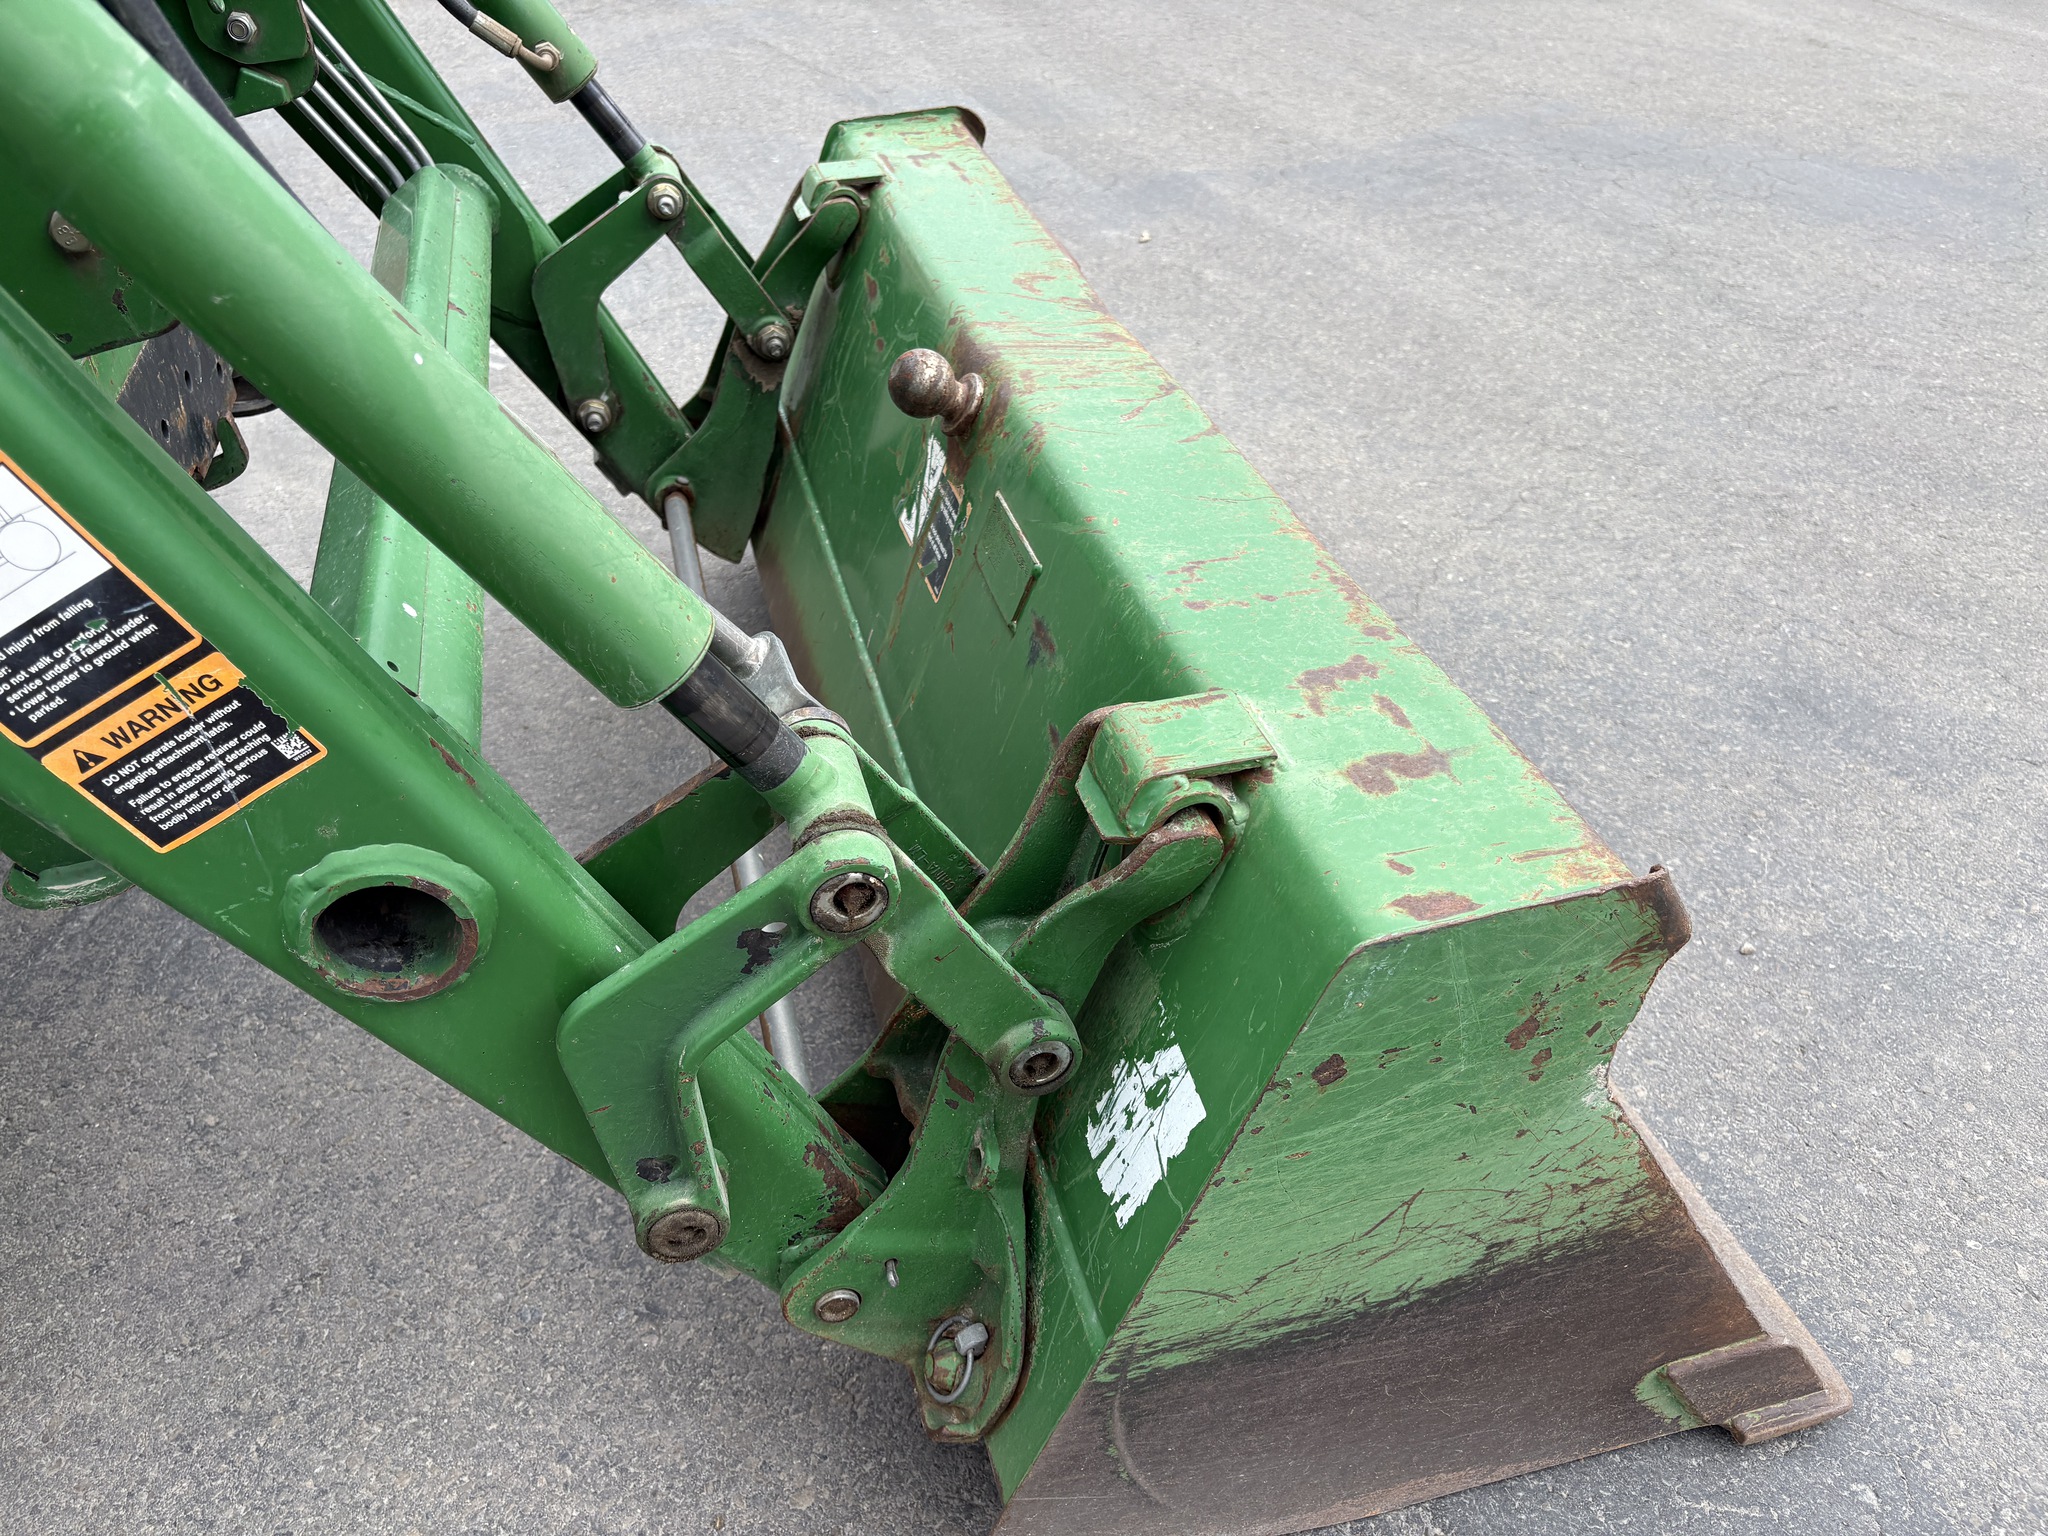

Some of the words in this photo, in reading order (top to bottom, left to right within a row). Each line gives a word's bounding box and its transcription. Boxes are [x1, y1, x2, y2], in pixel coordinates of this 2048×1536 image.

[4, 633, 34, 656] injury
[33, 618, 61, 637] from
[58, 598, 93, 621] falling
[6, 678, 44, 704] service
[43, 658, 76, 681] under
[73, 654, 82, 663] a
[81, 634, 115, 657] raised
[113, 614, 150, 638] loader.
[11, 670, 32, 685] not
[31, 656, 54, 672] walk
[53, 648, 66, 659] or
[15, 691, 49, 713] Lower
[46, 670, 81, 694] loader
[80, 663, 94, 674] to
[93, 641, 130, 666] ground
[128, 624, 159, 643] when
[29, 696, 68, 723] parked.
[101, 674, 224, 752] WARNNG
[102, 773, 121, 787] DO
[118, 760, 140, 777] NOT
[140, 741, 176, 764] operate
[175, 722, 206, 742] loader
[206, 700, 242, 724] without
[114, 766, 158, 795] engaging
[156, 735, 208, 769] attachment
[205, 722, 234, 739] latch.
[128, 786, 162, 808] Failure
[159, 779, 172, 789] to
[171, 759, 206, 783] engage
[204, 737, 240, 762] retainer
[240, 722, 267, 741] could
[140, 797, 168, 815] result
[166, 790, 177, 800] in
[175, 761, 226, 794] attachment
[224, 734, 272, 763] detaching
[149, 806, 174, 823] from
[171, 789, 201, 810] loader
[199, 768, 236, 793] causing
[234, 748, 269, 771] serious
[159, 811, 189, 831] bodily
[186, 797, 213, 815] injury
[211, 790, 223, 800] or
[222, 775, 252, 792] death.
